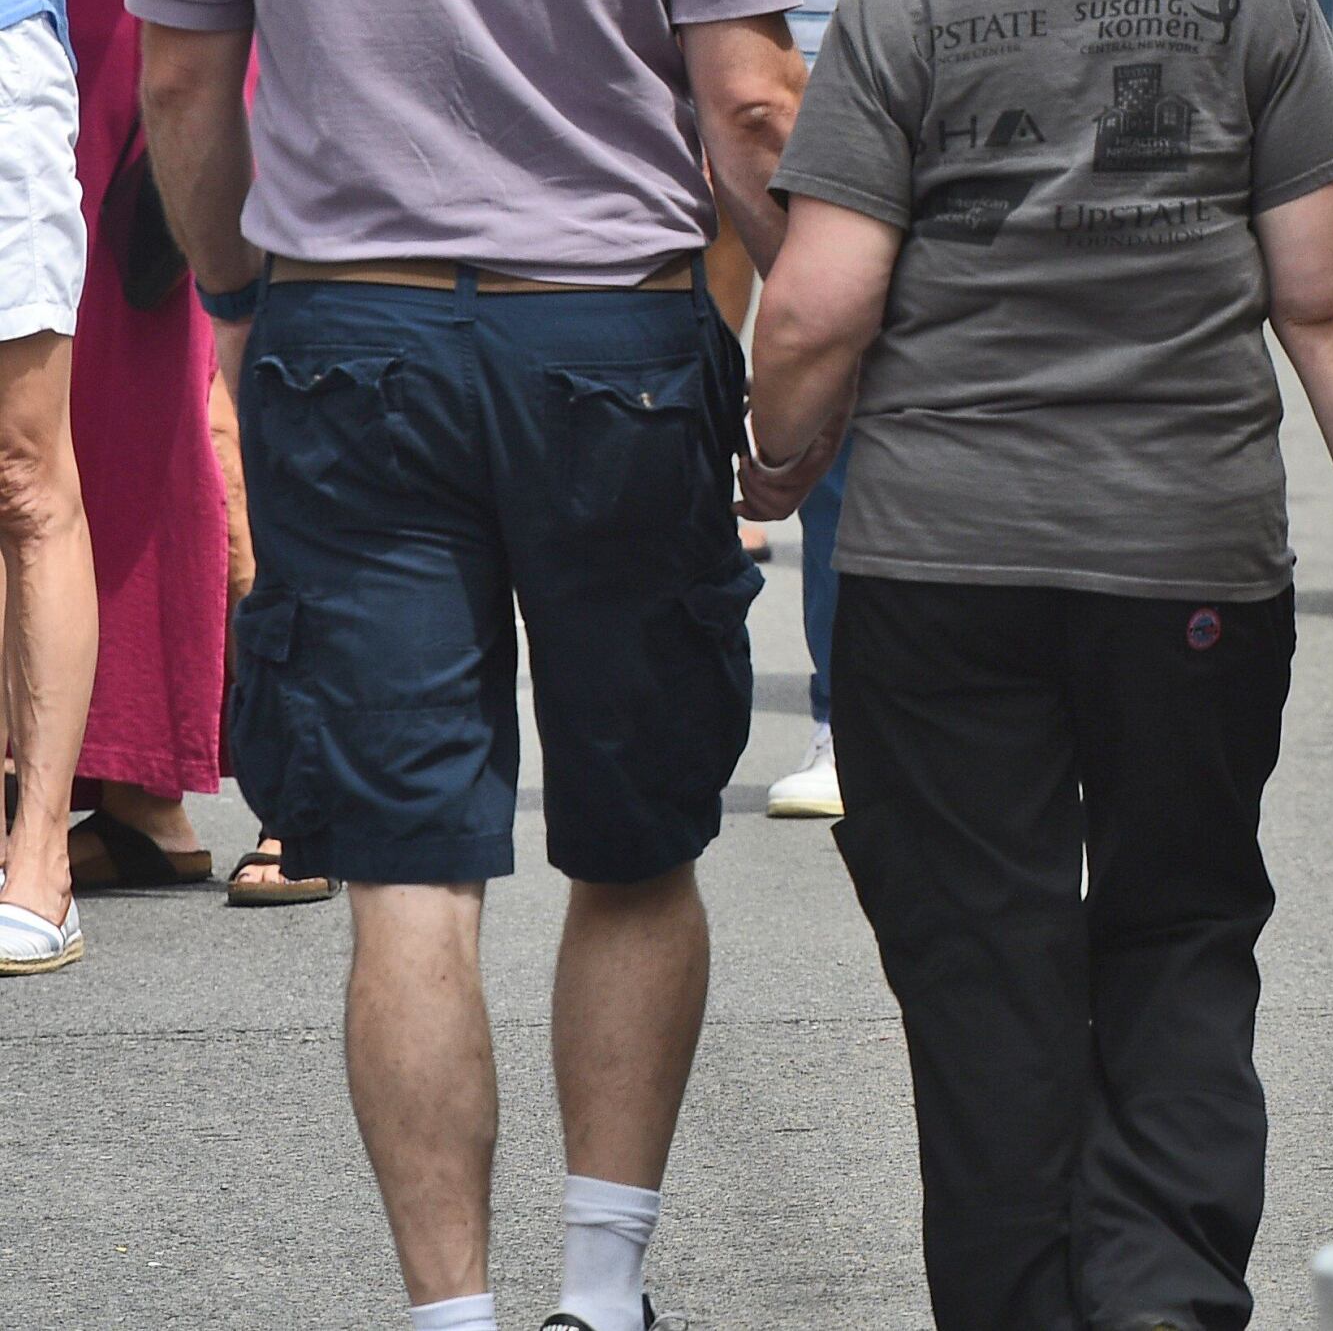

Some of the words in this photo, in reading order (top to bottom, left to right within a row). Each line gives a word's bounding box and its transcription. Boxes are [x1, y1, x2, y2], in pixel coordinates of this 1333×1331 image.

[1080, 40, 1134, 54] CENTRAL
[1138, 39, 1165, 50] NEW
[1168, 41, 1199, 55] YORK
[1055, 200, 1211, 232] UPSTATE
[1065, 228, 1205, 249] FOUNDATION
